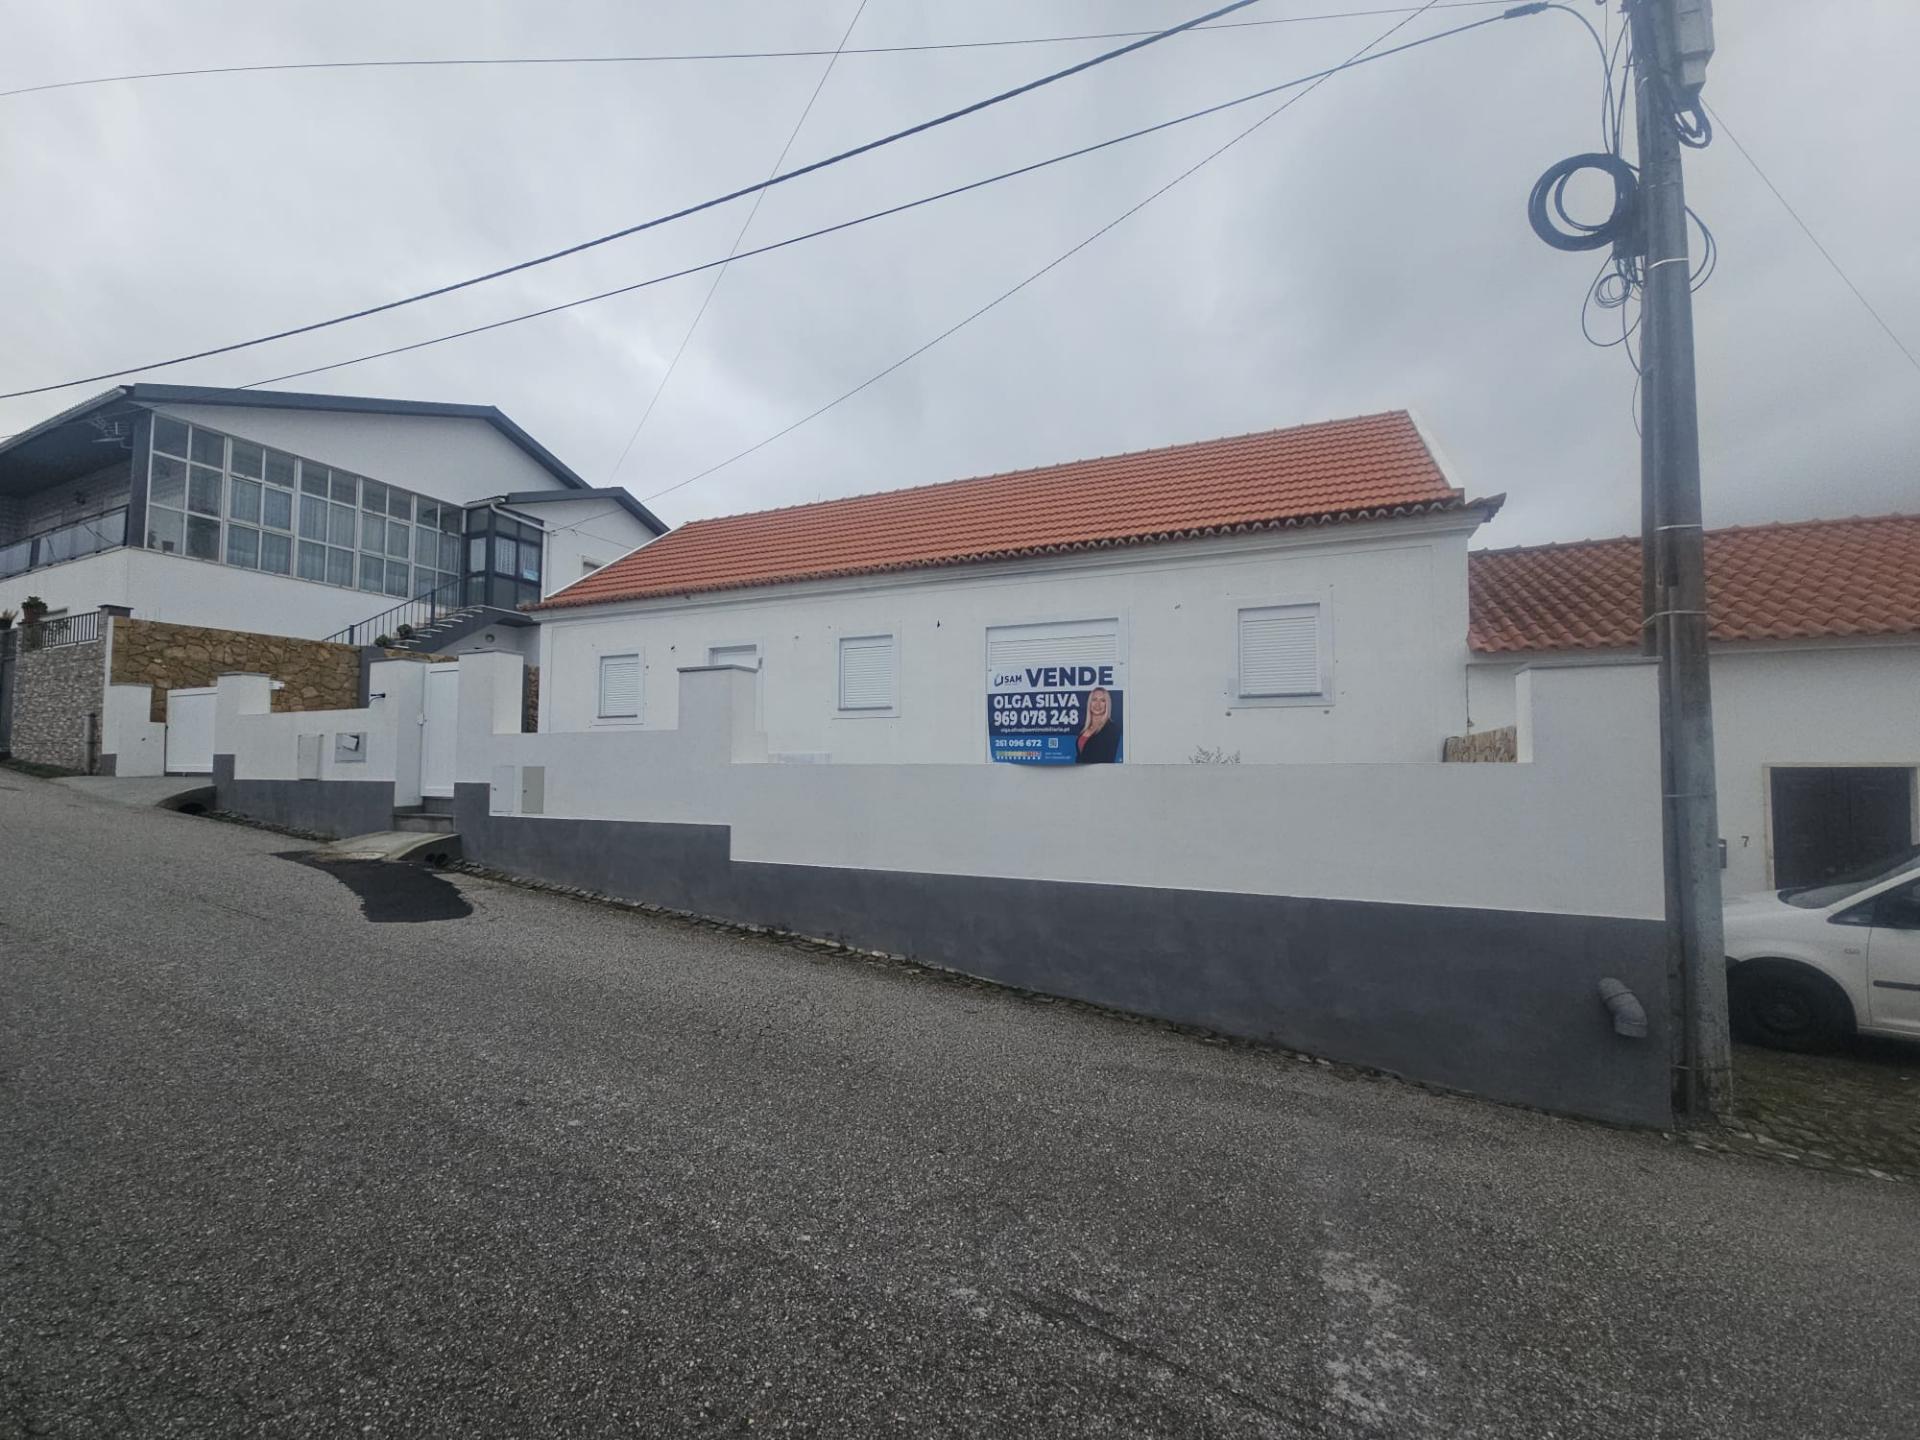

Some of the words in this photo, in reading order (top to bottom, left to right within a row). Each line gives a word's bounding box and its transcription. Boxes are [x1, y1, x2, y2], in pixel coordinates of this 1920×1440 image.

[1005, 675, 1022, 683] SAM
[1026, 666, 1113, 687] VENDE
[994, 695, 1032, 709] OLGA
[1036, 694, 1079, 708] SILVA
[994, 712, 1017, 726] 969
[1021, 711, 1046, 725] 078
[1050, 710, 1078, 724] 248
[1741, 836, 1749, 847] 7
